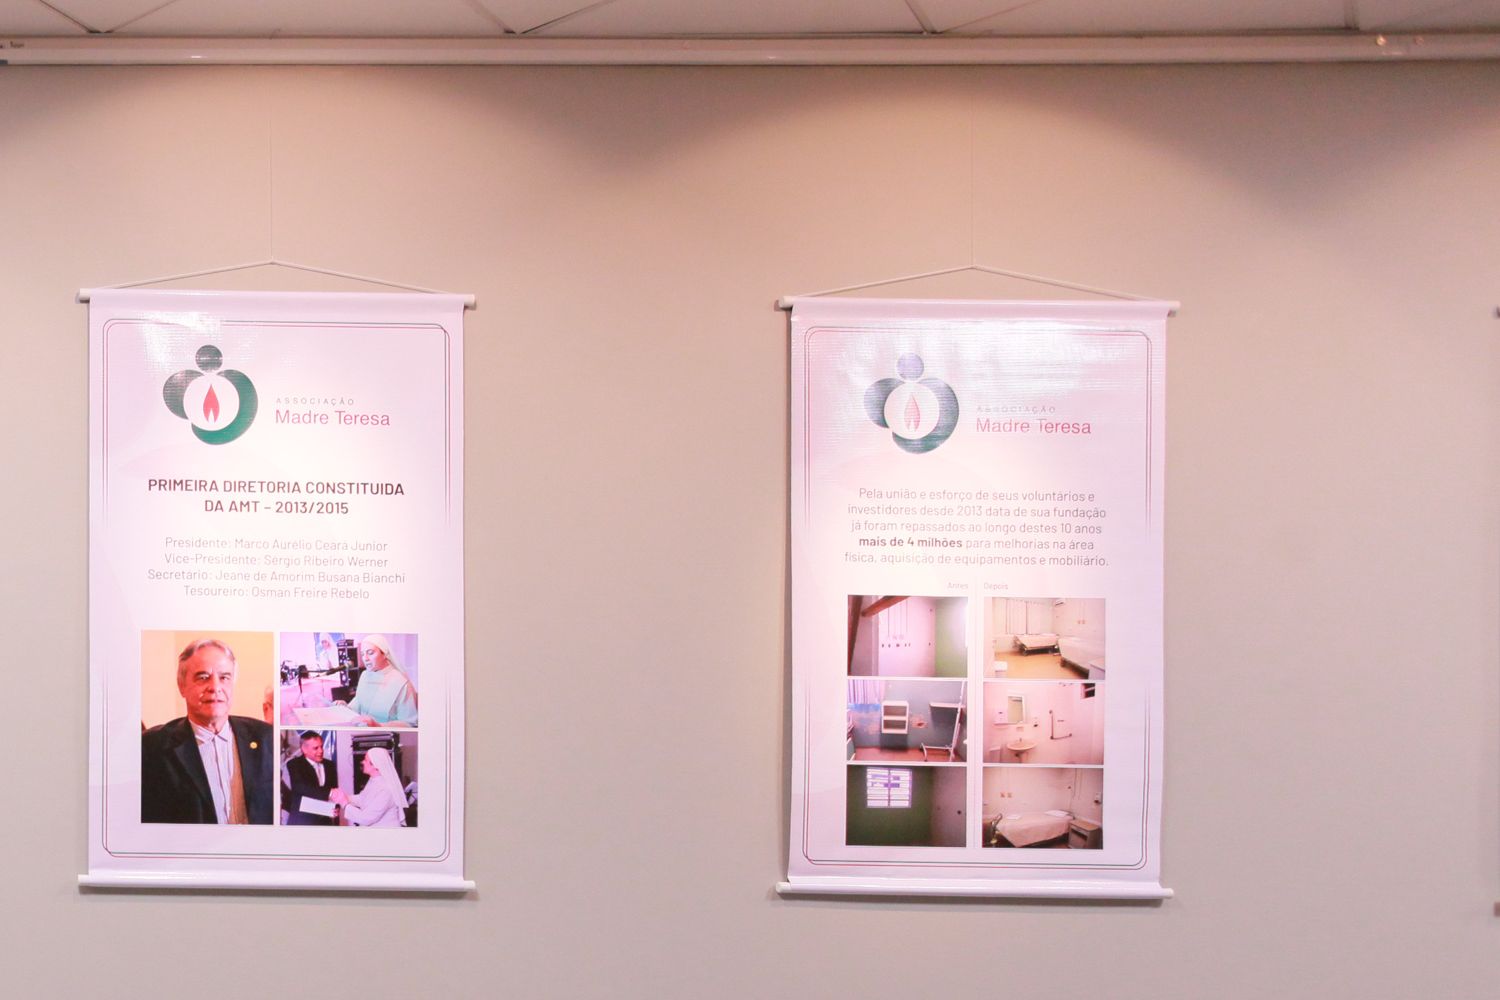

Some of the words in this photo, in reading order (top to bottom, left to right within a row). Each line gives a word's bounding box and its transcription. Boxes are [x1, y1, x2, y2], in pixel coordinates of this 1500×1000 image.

[276, 396, 354, 406] ASSOCIAÇÃO
[276, 409, 328, 424] Madre
[334, 410, 390, 426] Teresa
[976, 418, 1030, 433] Madre
[1038, 418, 1091, 434] Teresa
[148, 478, 218, 492] PRIMEIRA
[223, 480, 301, 494] DIRETORIA
[306, 481, 404, 495] CONSTITUIDA
[859, 487, 882, 498] Pela
[886, 488, 916, 499] união
[929, 489, 972, 502] esforço
[976, 490, 989, 500] de
[992, 492, 1018, 501] seus
[205, 500, 224, 512] DA
[228, 500, 260, 512] AMT
[275, 501, 348, 514] 2013/2015
[848, 504, 917, 515] investidores
[920, 505, 953, 516] desde
[957, 505, 982, 516] 2013
[986, 507, 1010, 516] data
[1014, 507, 1027, 516] de
[1030, 509, 1050, 517] sua
[1053, 507, 1106, 520] fundação
[864, 520, 897, 530] foram
[901, 522, 965, 534] repassados
[968, 524, 981, 532] ao
[985, 523, 1016, 535] longo
[1019, 523, 1057, 533] destes
[1061, 523, 1071, 533] 10
[1074, 526, 1102, 534] anos
[235, 538, 269, 549] Marco
[351, 540, 388, 551] Junior
[859, 536, 886, 546] mais
[890, 537, 904, 546] de
[966, 540, 990, 548] para
[994, 538, 1050, 549] melhorias
[1053, 541, 1066, 549] na
[304, 555, 344, 566] Ribeiro
[347, 557, 388, 567] Werner
[880, 555, 934, 566] aquisição
[937, 555, 951, 564] de
[954, 554, 1036, 567] equipamentos
[215, 570, 250, 580] Jeane
[254, 571, 267, 581] de
[270, 571, 314, 582] Amorim
[318, 572, 359, 582] Busana
[363, 572, 405, 583] Bianchi
[252, 586, 290, 598] Osman
[294, 587, 327, 598] Freire
[331, 588, 369, 599] Rebelo
